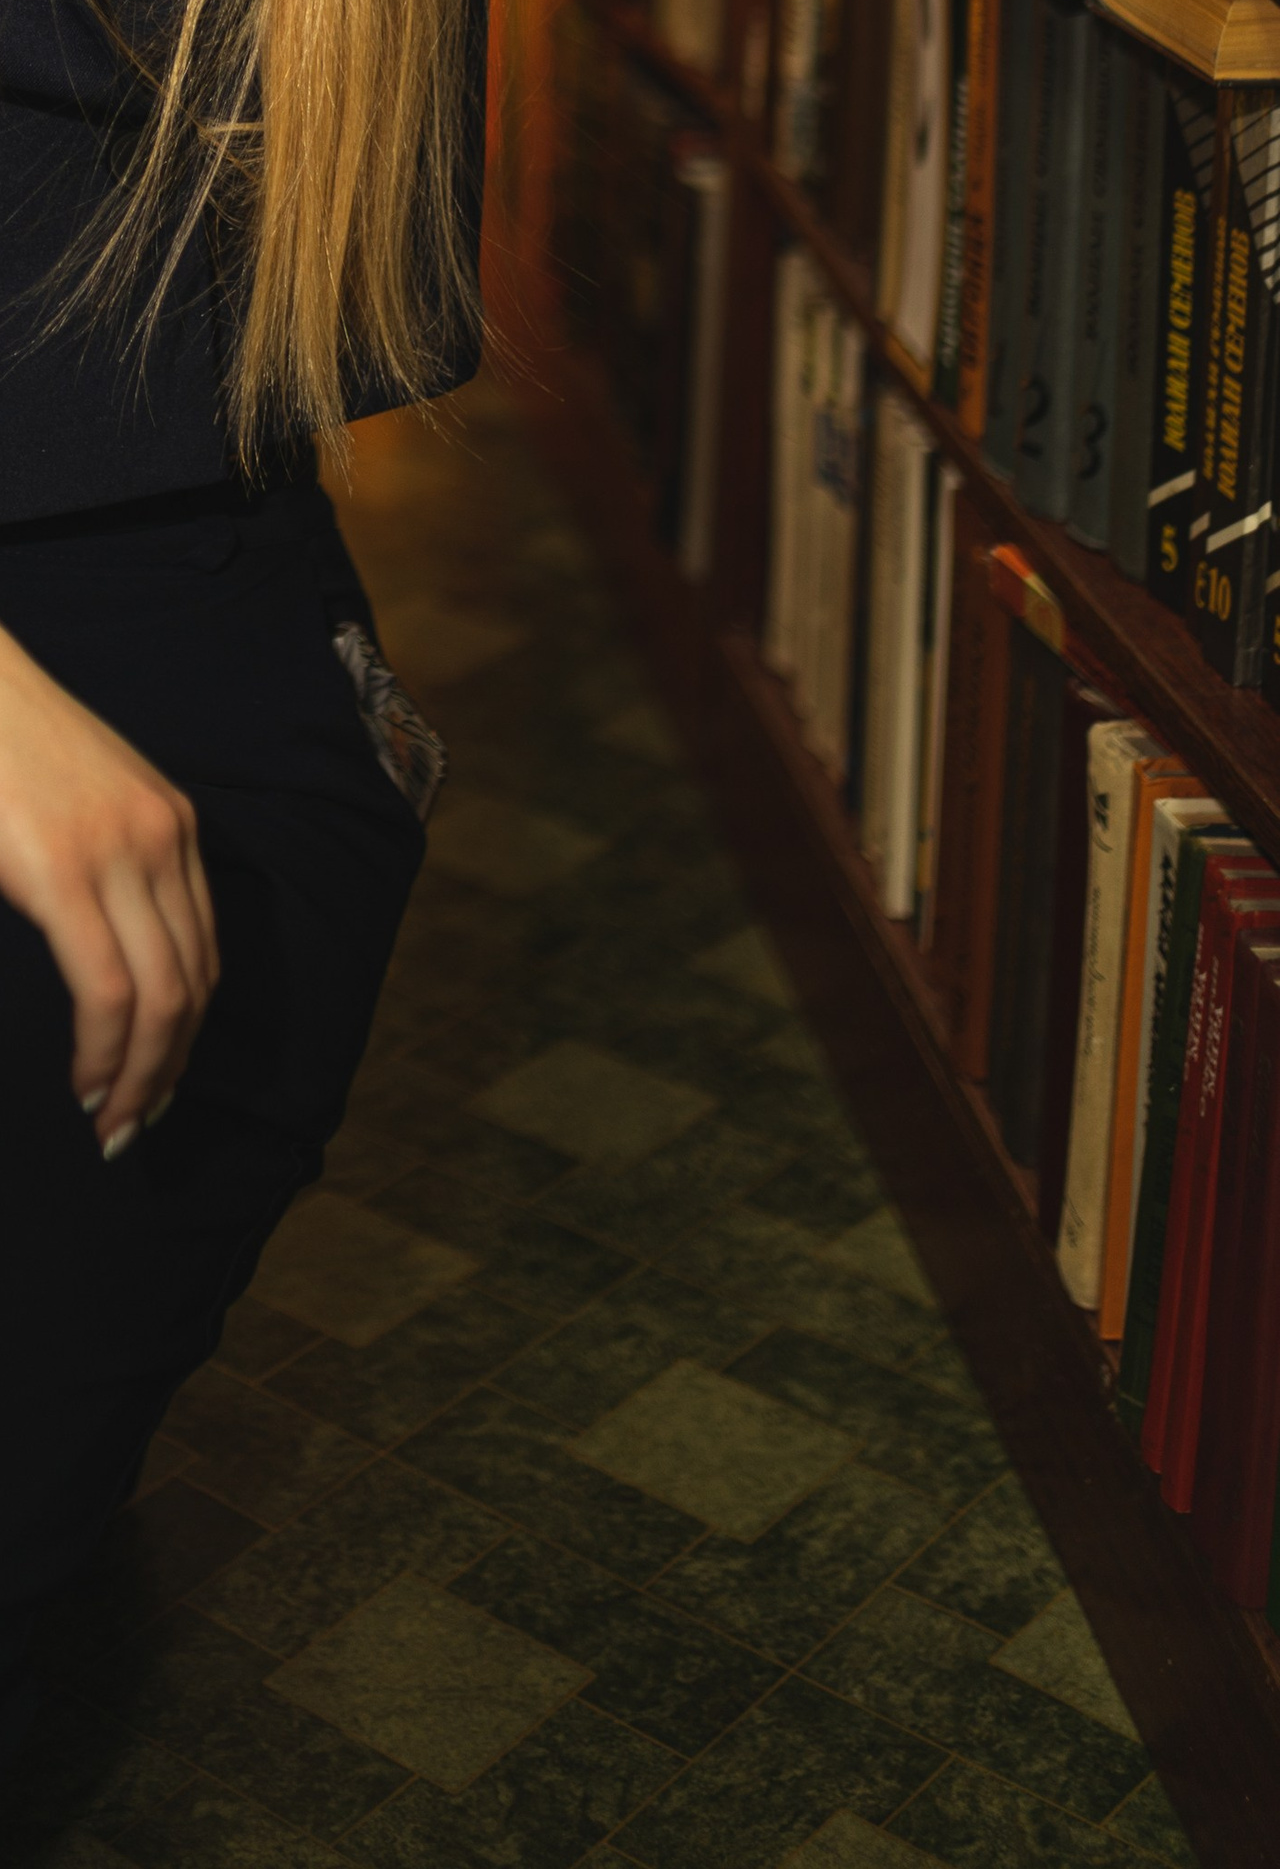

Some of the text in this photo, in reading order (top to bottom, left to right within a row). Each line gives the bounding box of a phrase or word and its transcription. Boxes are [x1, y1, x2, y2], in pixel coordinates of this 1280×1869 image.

[1167, 188, 1197, 331] СЕМЕНОВ
[1223, 227, 1250, 374] СЕМЕНОВ
[1078, 402, 1109, 480] 3
[1160, 523, 1179, 573] 5
[1207, 565, 1232, 621] 10
